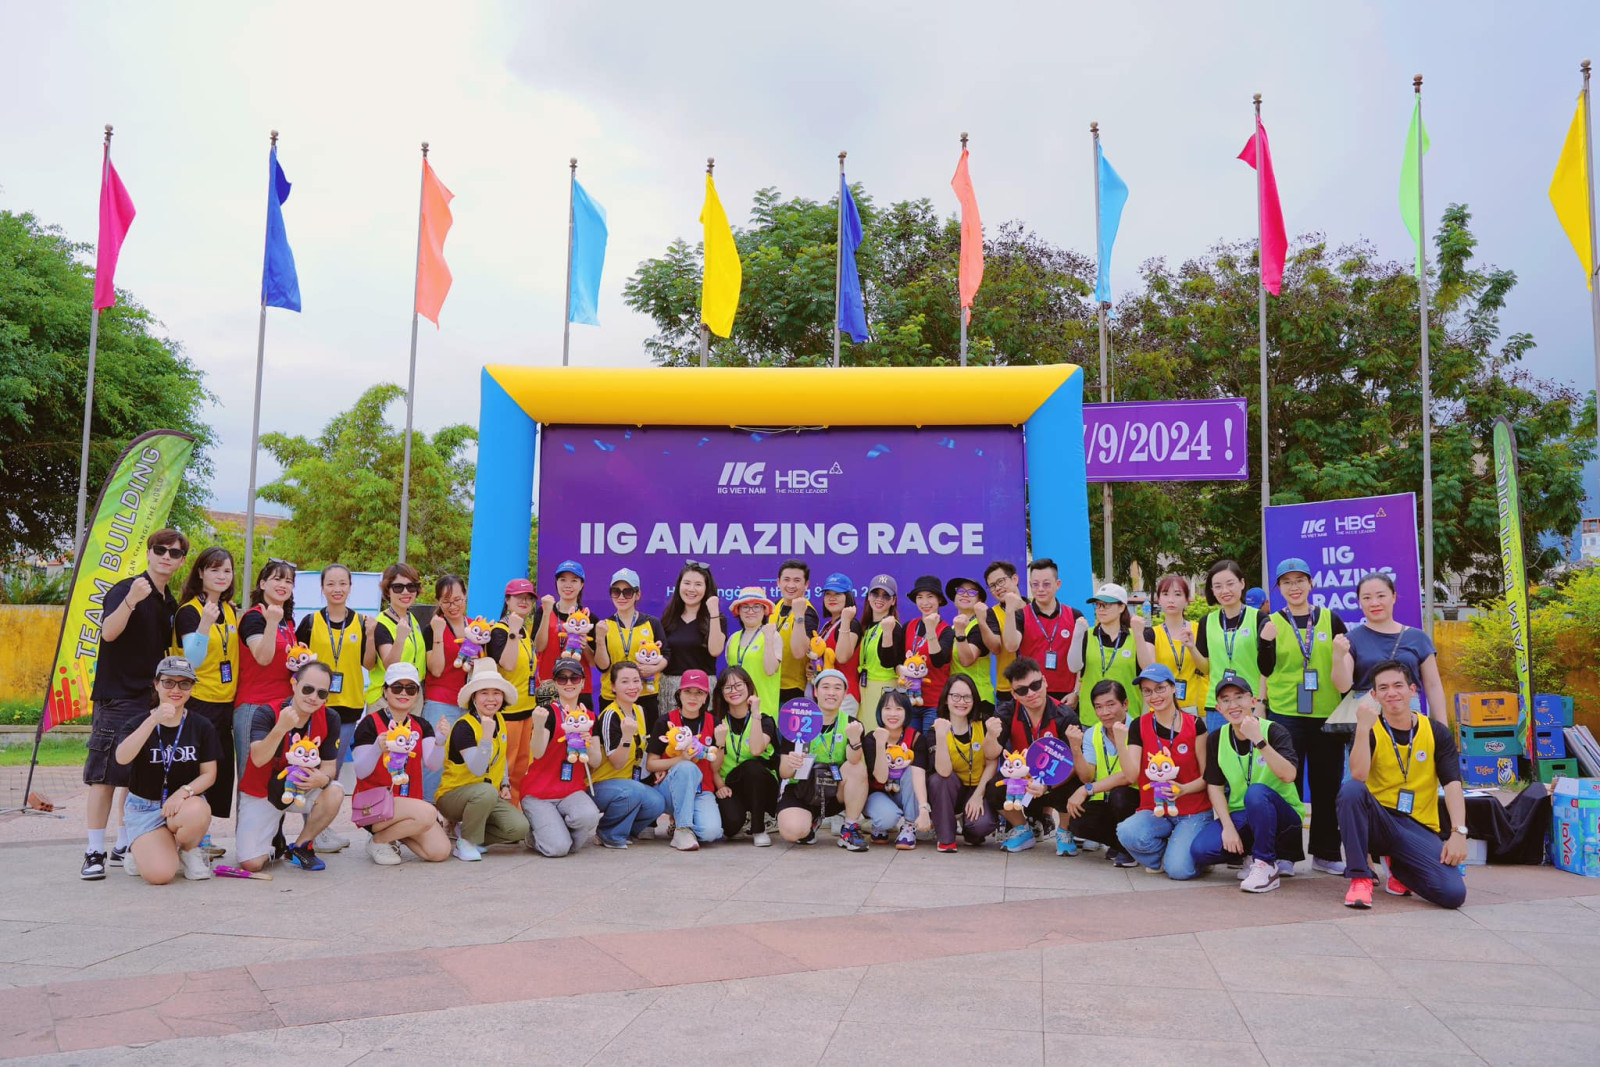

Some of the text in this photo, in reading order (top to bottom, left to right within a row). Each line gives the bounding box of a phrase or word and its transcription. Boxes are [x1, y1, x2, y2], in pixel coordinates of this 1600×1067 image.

[1083, 420, 1211, 464] /9/2024
[718, 462, 766, 486] IIG
[775, 470, 828, 489] HBG
[128, 477, 165, 576] CAN CHANGE THE WORLD
[1301, 519, 1326, 534] IIG
[1335, 514, 1376, 532] HBG
[580, 522, 984, 555] IIG AMAZING RACE
[75, 446, 161, 660] TEAM BUILDING
[1322, 546, 1355, 565] IIG
[1311, 566, 1397, 588] MAZING
[770, 585, 811, 600] thg
[1312, 592, 1362, 611] RAC
[791, 708, 812, 716] TEAM
[789, 716, 812, 732] 02
[150, 744, 197, 764] DIOR
[1044, 745, 1065, 761] TEAM
[1036, 753, 1059, 777] 01
[1475, 766, 1495, 775] Tiger
